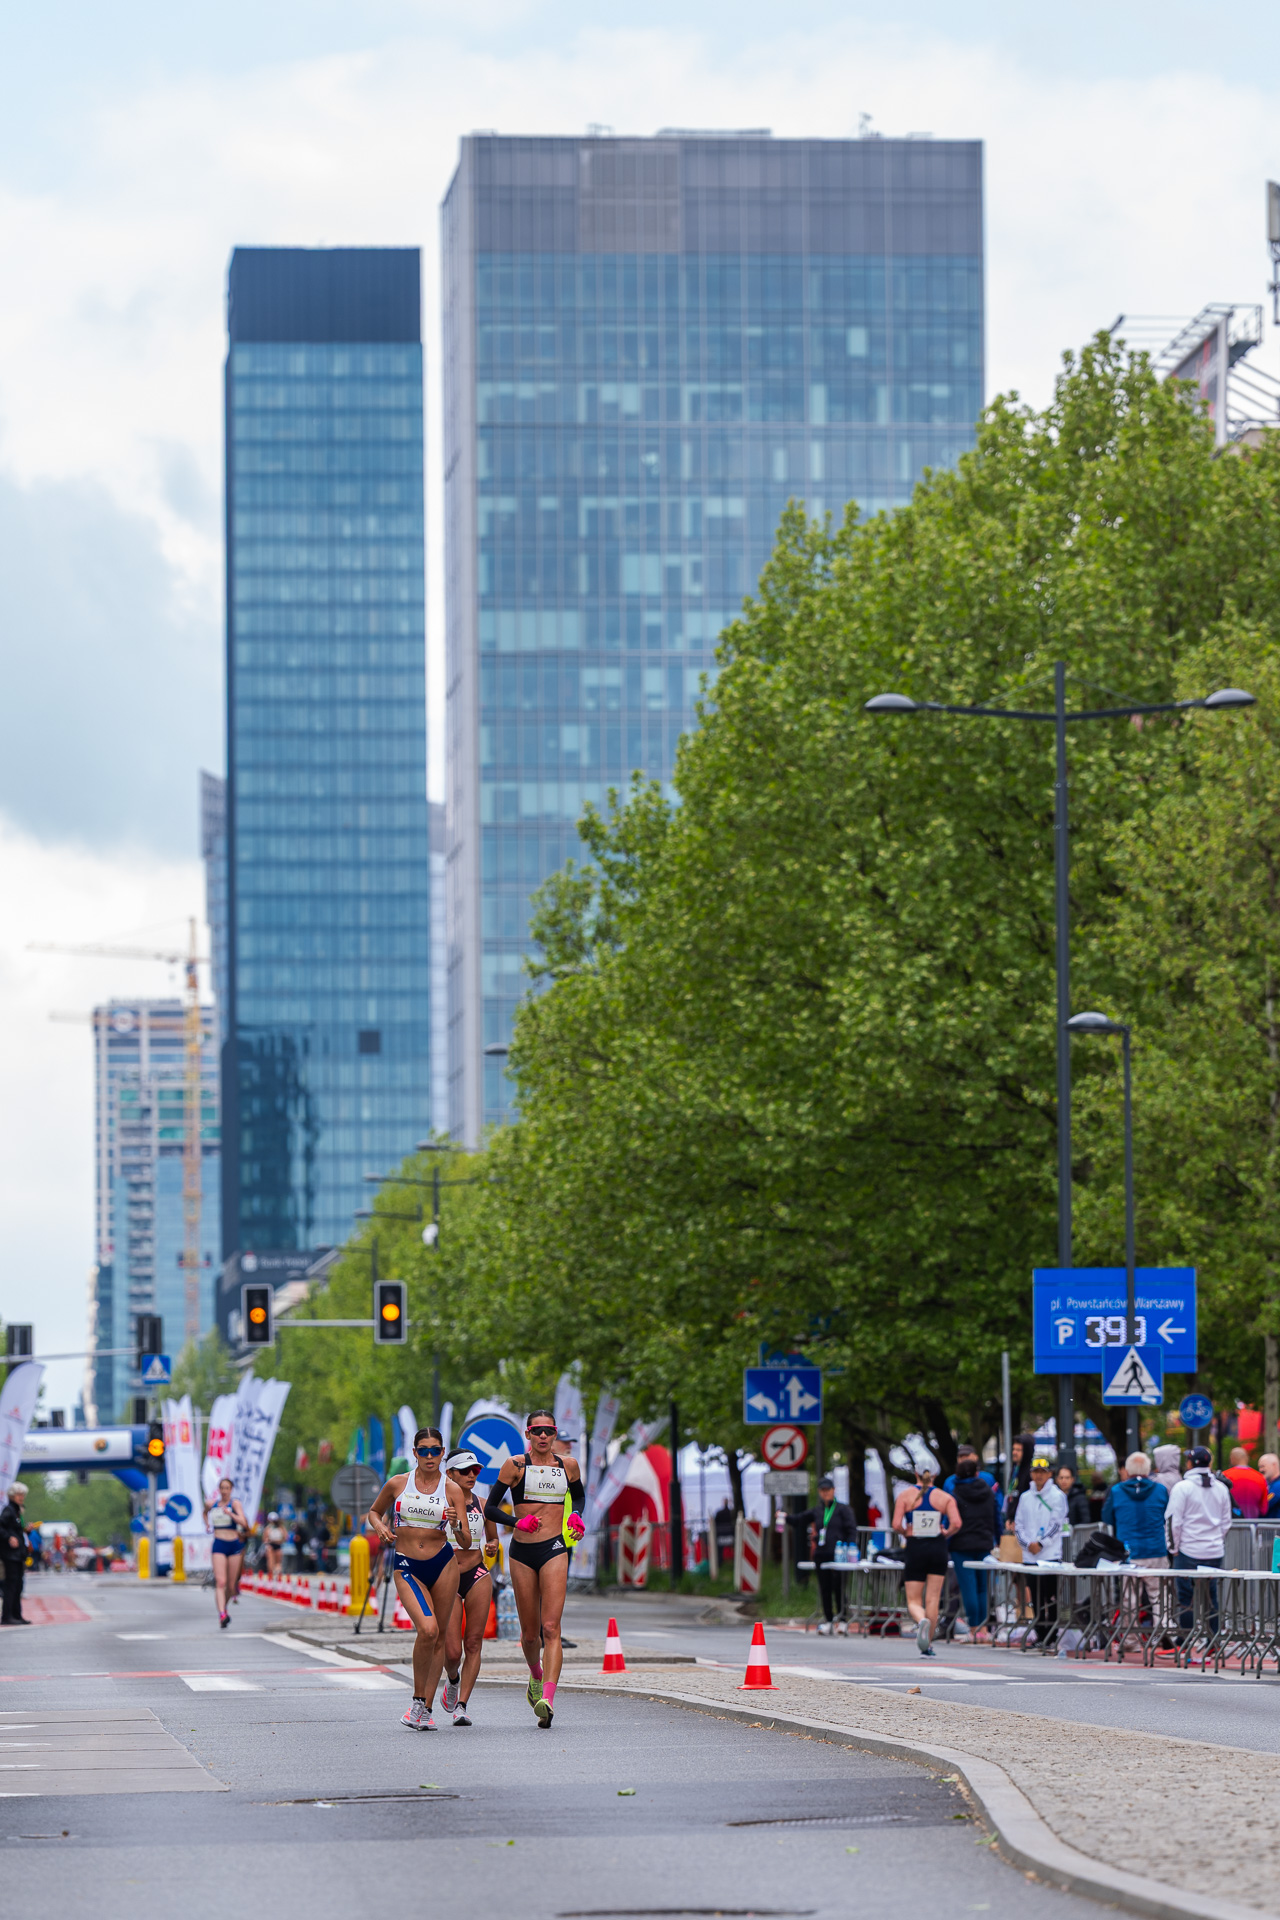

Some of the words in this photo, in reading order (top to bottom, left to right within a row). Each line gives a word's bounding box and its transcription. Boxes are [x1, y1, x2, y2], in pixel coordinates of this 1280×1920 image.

[1051, 1297, 1061, 1312] pl.
[1058, 1324, 1074, 1345] P
[551, 1468, 562, 1477] 53
[538, 1482, 556, 1490] LYRA
[428, 1496, 440, 1505] 51
[407, 1506, 435, 1517] GARCÍA
[468, 1513, 479, 1523] 59
[921, 1517, 934, 1528] 57
